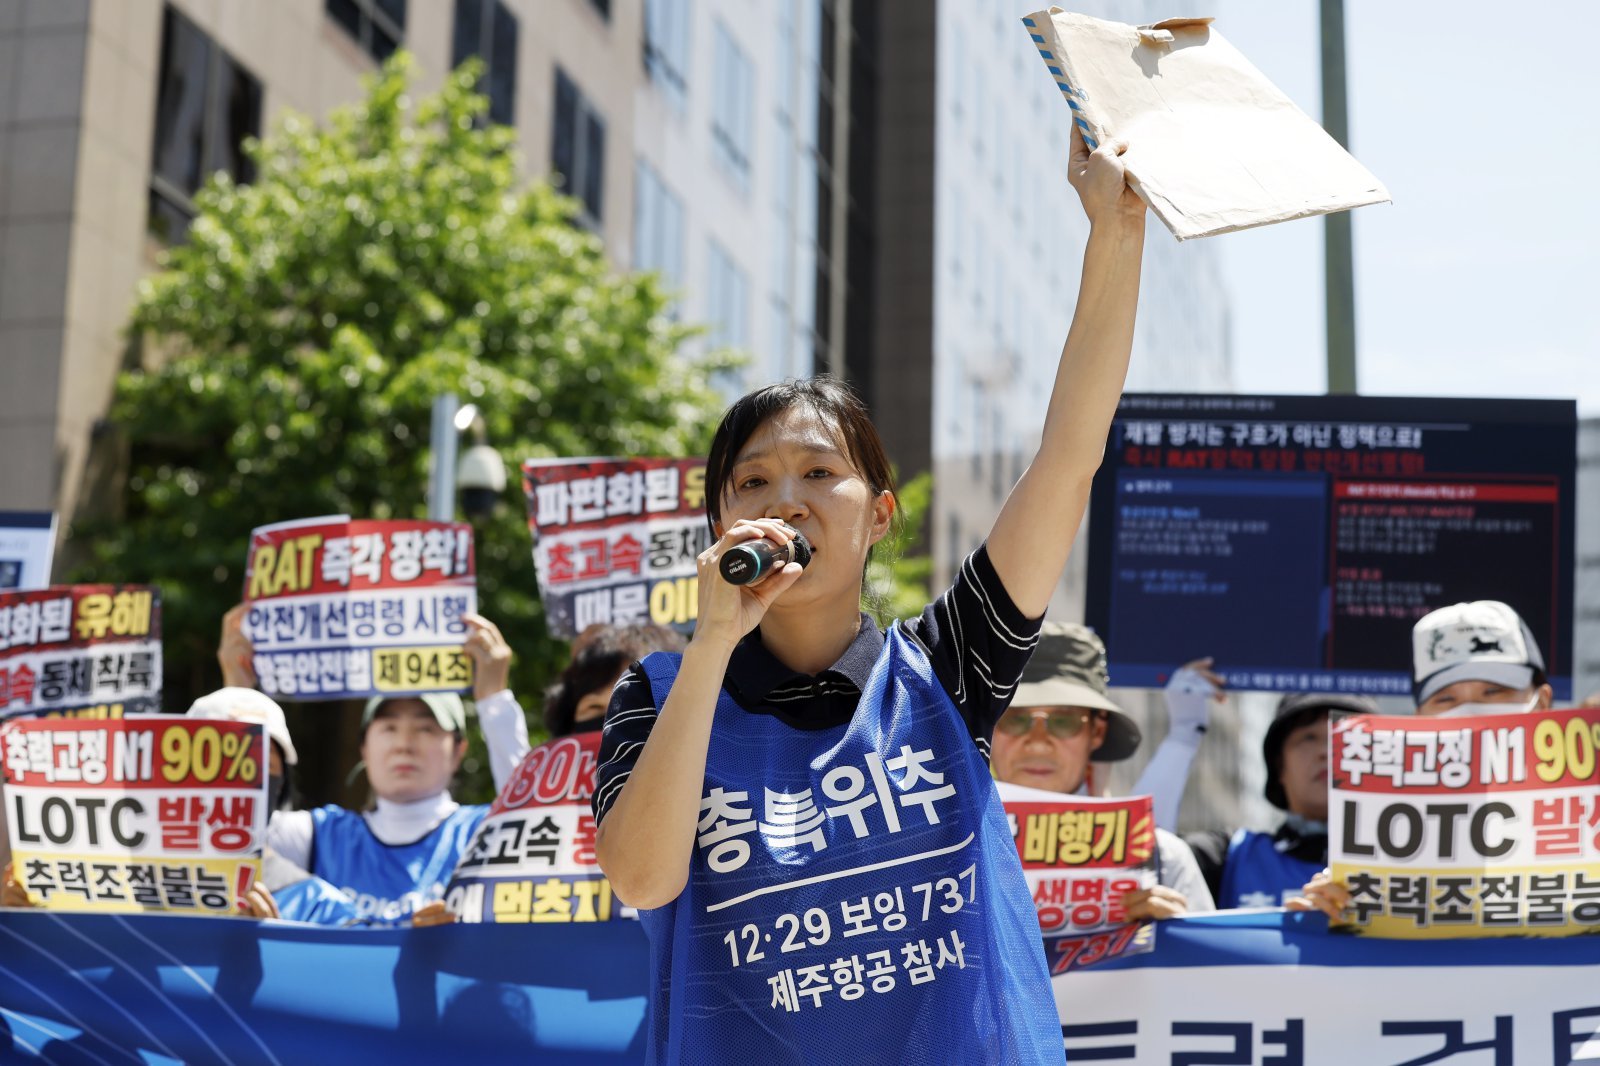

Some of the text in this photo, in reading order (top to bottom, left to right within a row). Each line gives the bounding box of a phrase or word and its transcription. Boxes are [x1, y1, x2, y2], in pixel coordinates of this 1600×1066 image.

[1124, 420, 1423, 449] 재발 방지는 구호가 아닌 정책으로!
[535, 467, 680, 526] 파편화된
[248, 528, 470, 599] RAT 즉각 장착!
[548, 533, 643, 586] 초고속
[76, 591, 152, 640] 유해
[248, 595, 469, 644] 안전개선명령 시행
[253, 650, 371, 694] 항공안전법
[6, 725, 257, 784] 추력고정 N1 90%
[1340, 727, 1472, 788] 추력고정
[1480, 726, 1527, 785] N1
[15, 795, 255, 851] LOTC 발생
[697, 744, 957, 874] 총특위추
[1023, 809, 1129, 864] 비행기
[1342, 800, 1517, 858] LOTC
[840, 886, 909, 938] 보잉
[912, 862, 977, 922] 737
[767, 929, 966, 1013] 제주항공 참사
[1053, 923, 1139, 973] 737
